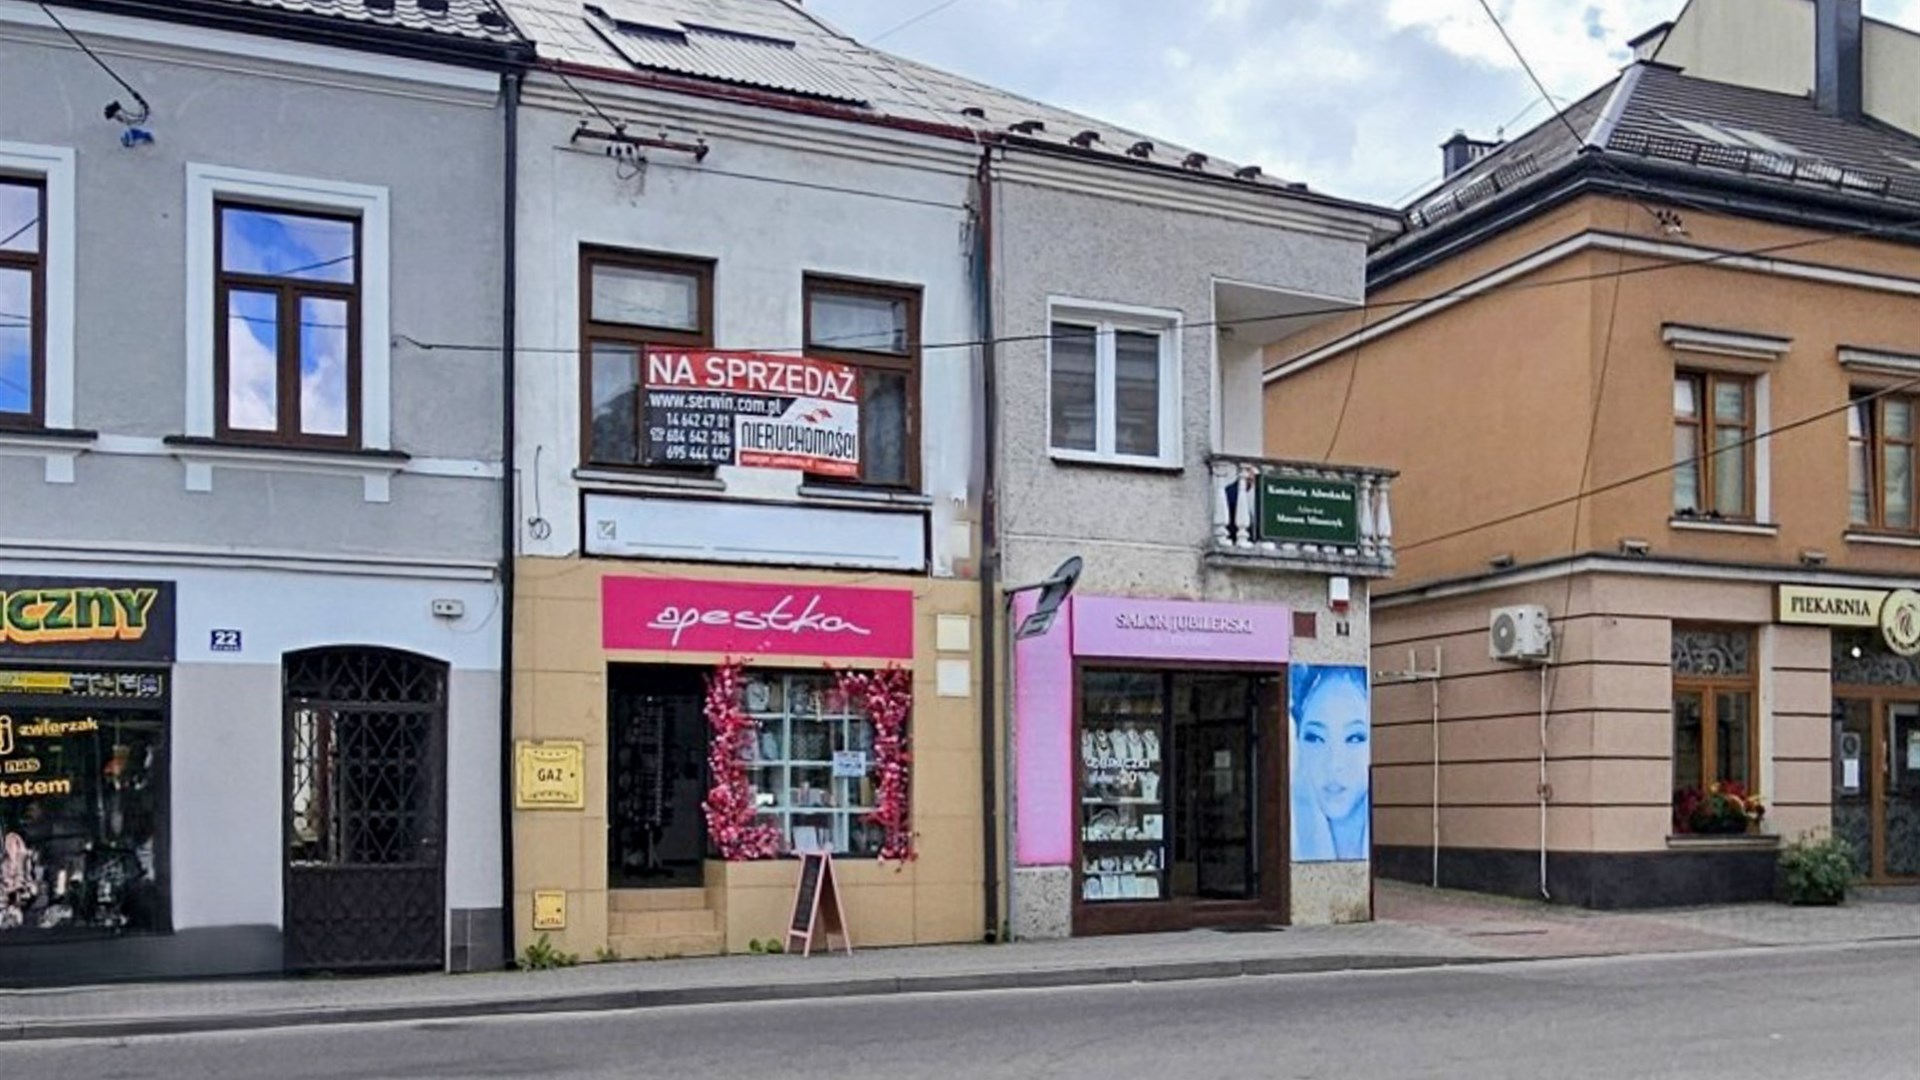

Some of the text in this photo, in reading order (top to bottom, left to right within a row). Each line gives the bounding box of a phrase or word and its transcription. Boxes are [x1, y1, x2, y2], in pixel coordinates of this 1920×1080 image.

[649, 354, 856, 402] NA SPRZEDAŻ
[649, 393, 781, 416] www.serwin.com.pl
[681, 413, 700, 427] 642
[702, 414, 715, 427] 47
[689, 430, 708, 444] 642
[741, 421, 855, 459] NIERUCHOMOŚCI
[689, 446, 708, 460] 444
[711, 447, 731, 461] 447
[0, 588, 158, 643] CZNY
[1791, 596, 1871, 617] PIEKARNIA
[1115, 612, 1167, 631] SALON
[215, 631, 237, 645] 22
[19, 717, 98, 735] zwierzak
[538, 767, 564, 782] GAZ
